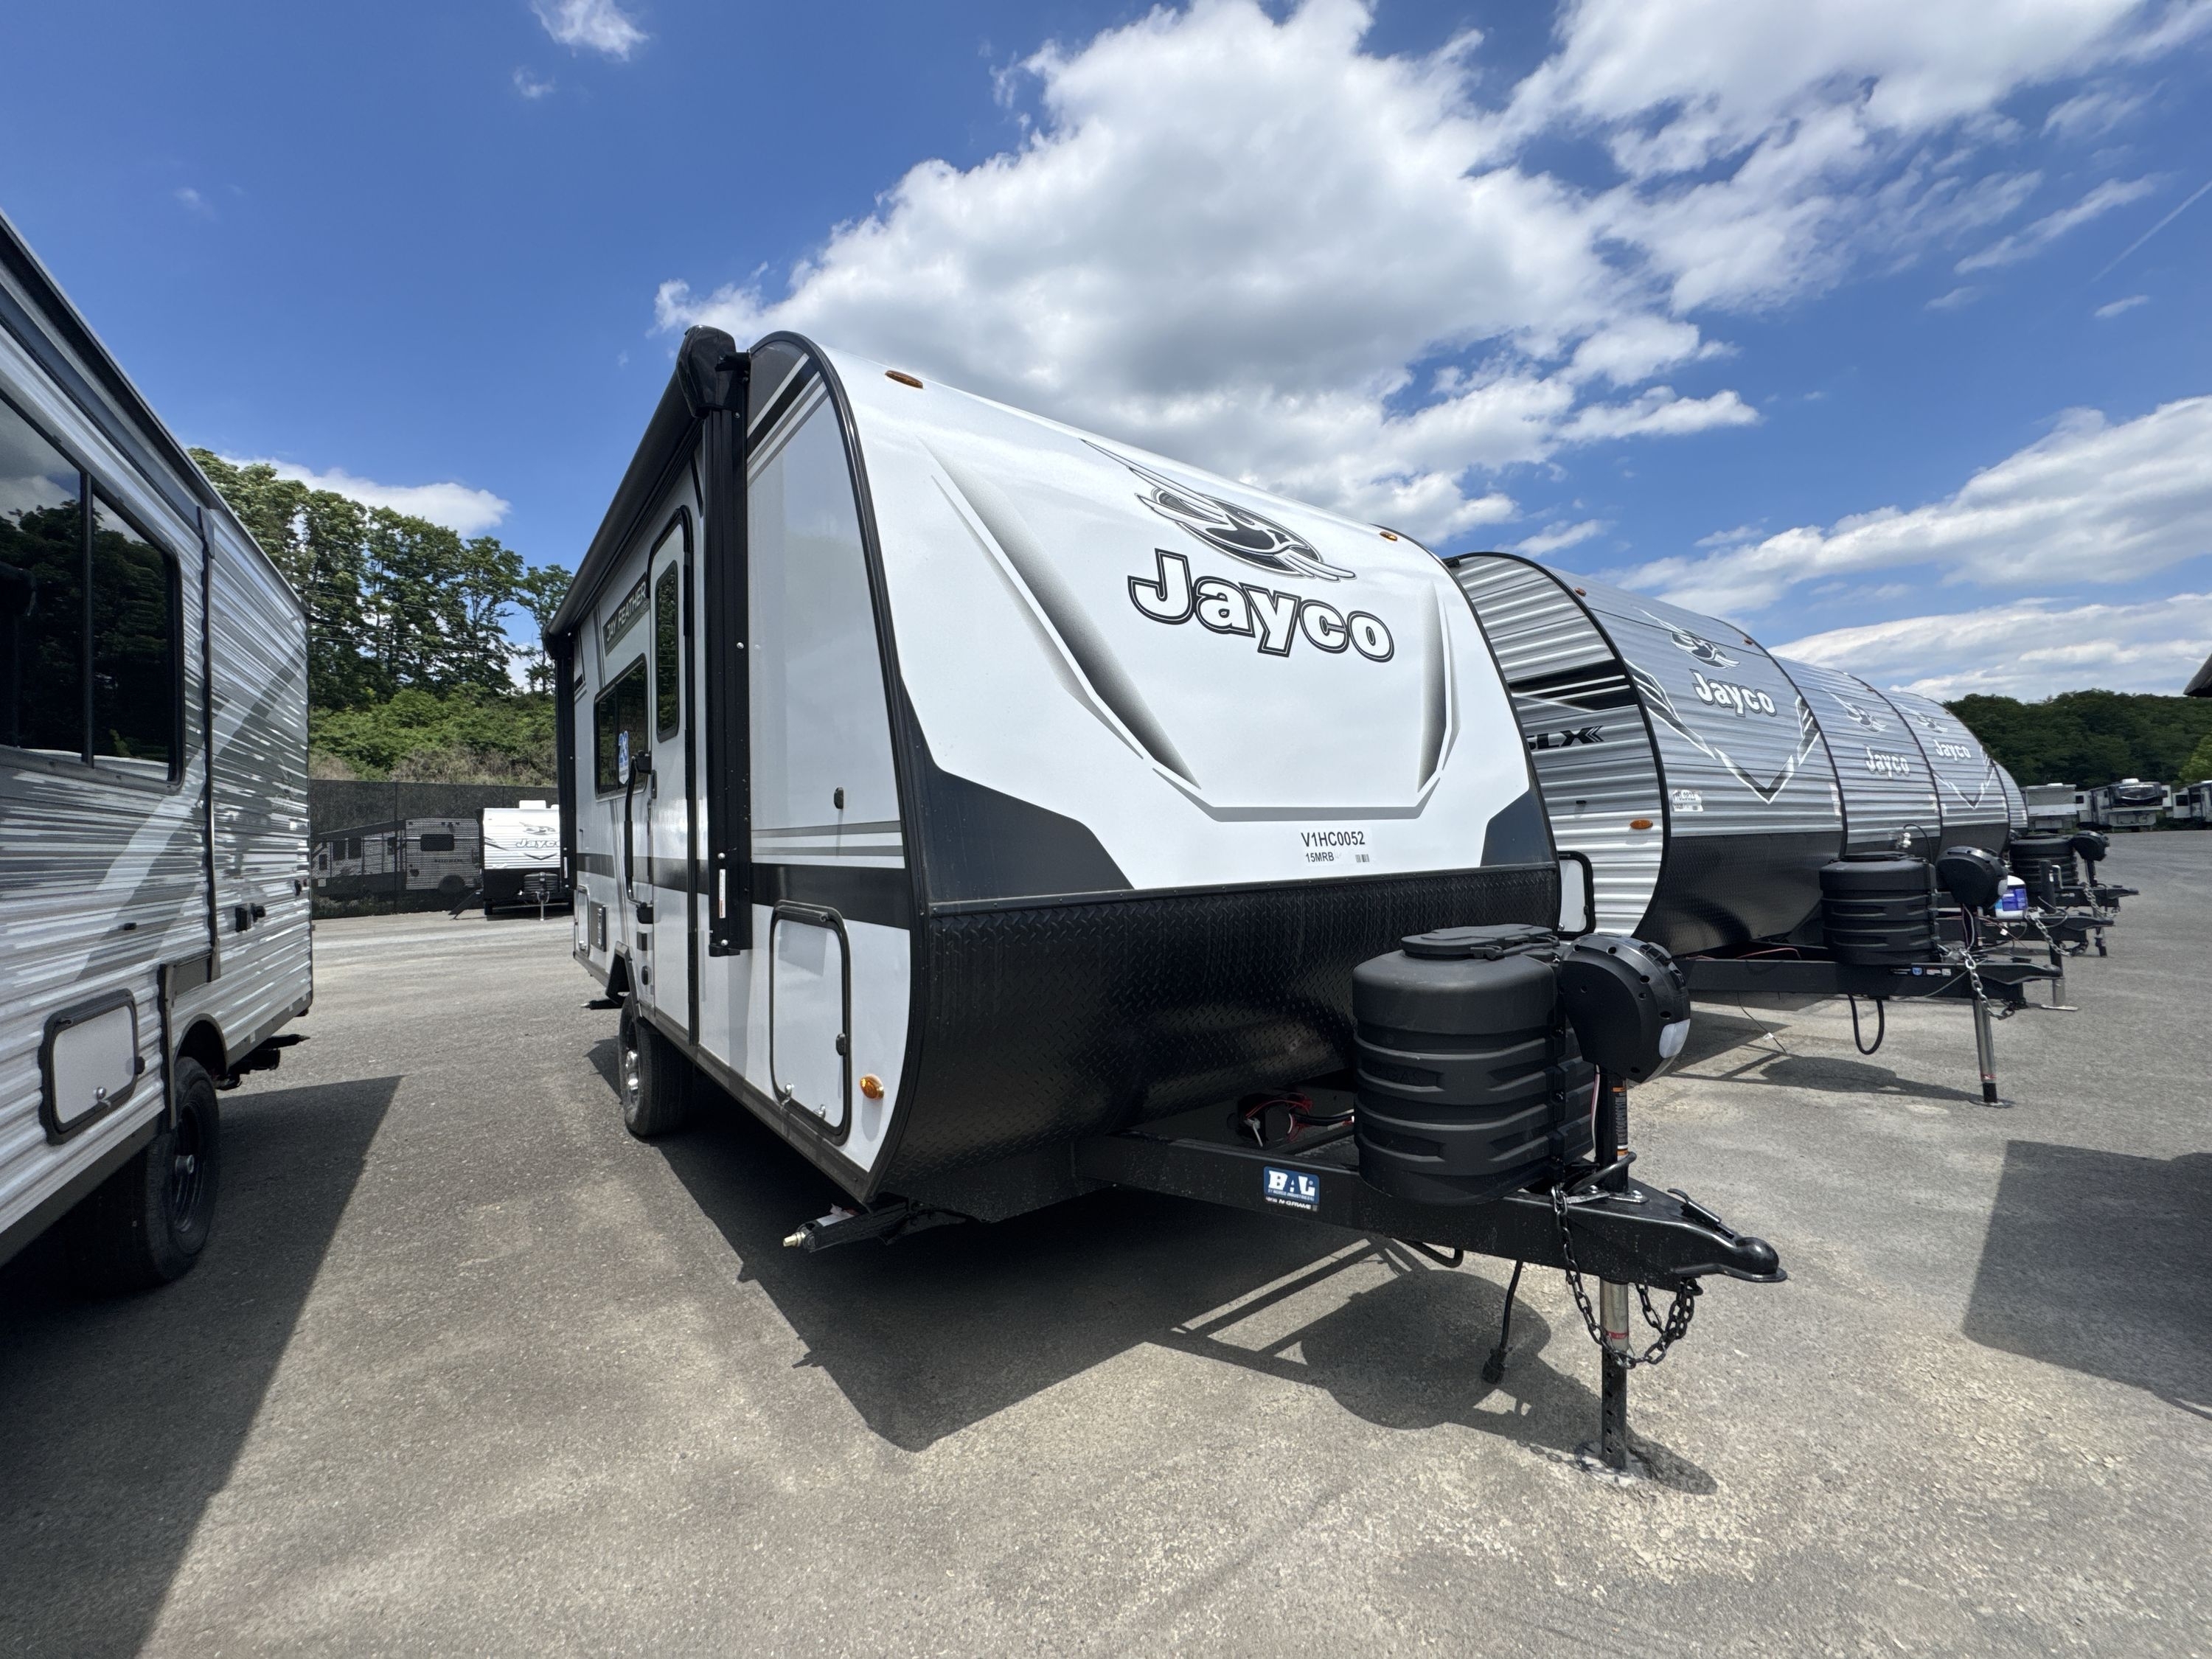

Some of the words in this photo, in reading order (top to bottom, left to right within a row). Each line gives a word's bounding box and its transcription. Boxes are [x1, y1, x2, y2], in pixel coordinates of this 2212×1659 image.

[607, 616, 617, 642] JAY
[618, 581, 647, 629] FEATHER
[1127, 548, 1395, 663] Jayco
[1688, 668, 1778, 717] Jayco
[1864, 744, 1910, 780] Jayco
[1933, 738, 1972, 762] Jayco
[1301, 831, 1366, 847] V1HC0052
[1305, 852, 1335, 863] 15MRB
[1268, 1170, 1315, 1197] BAL
